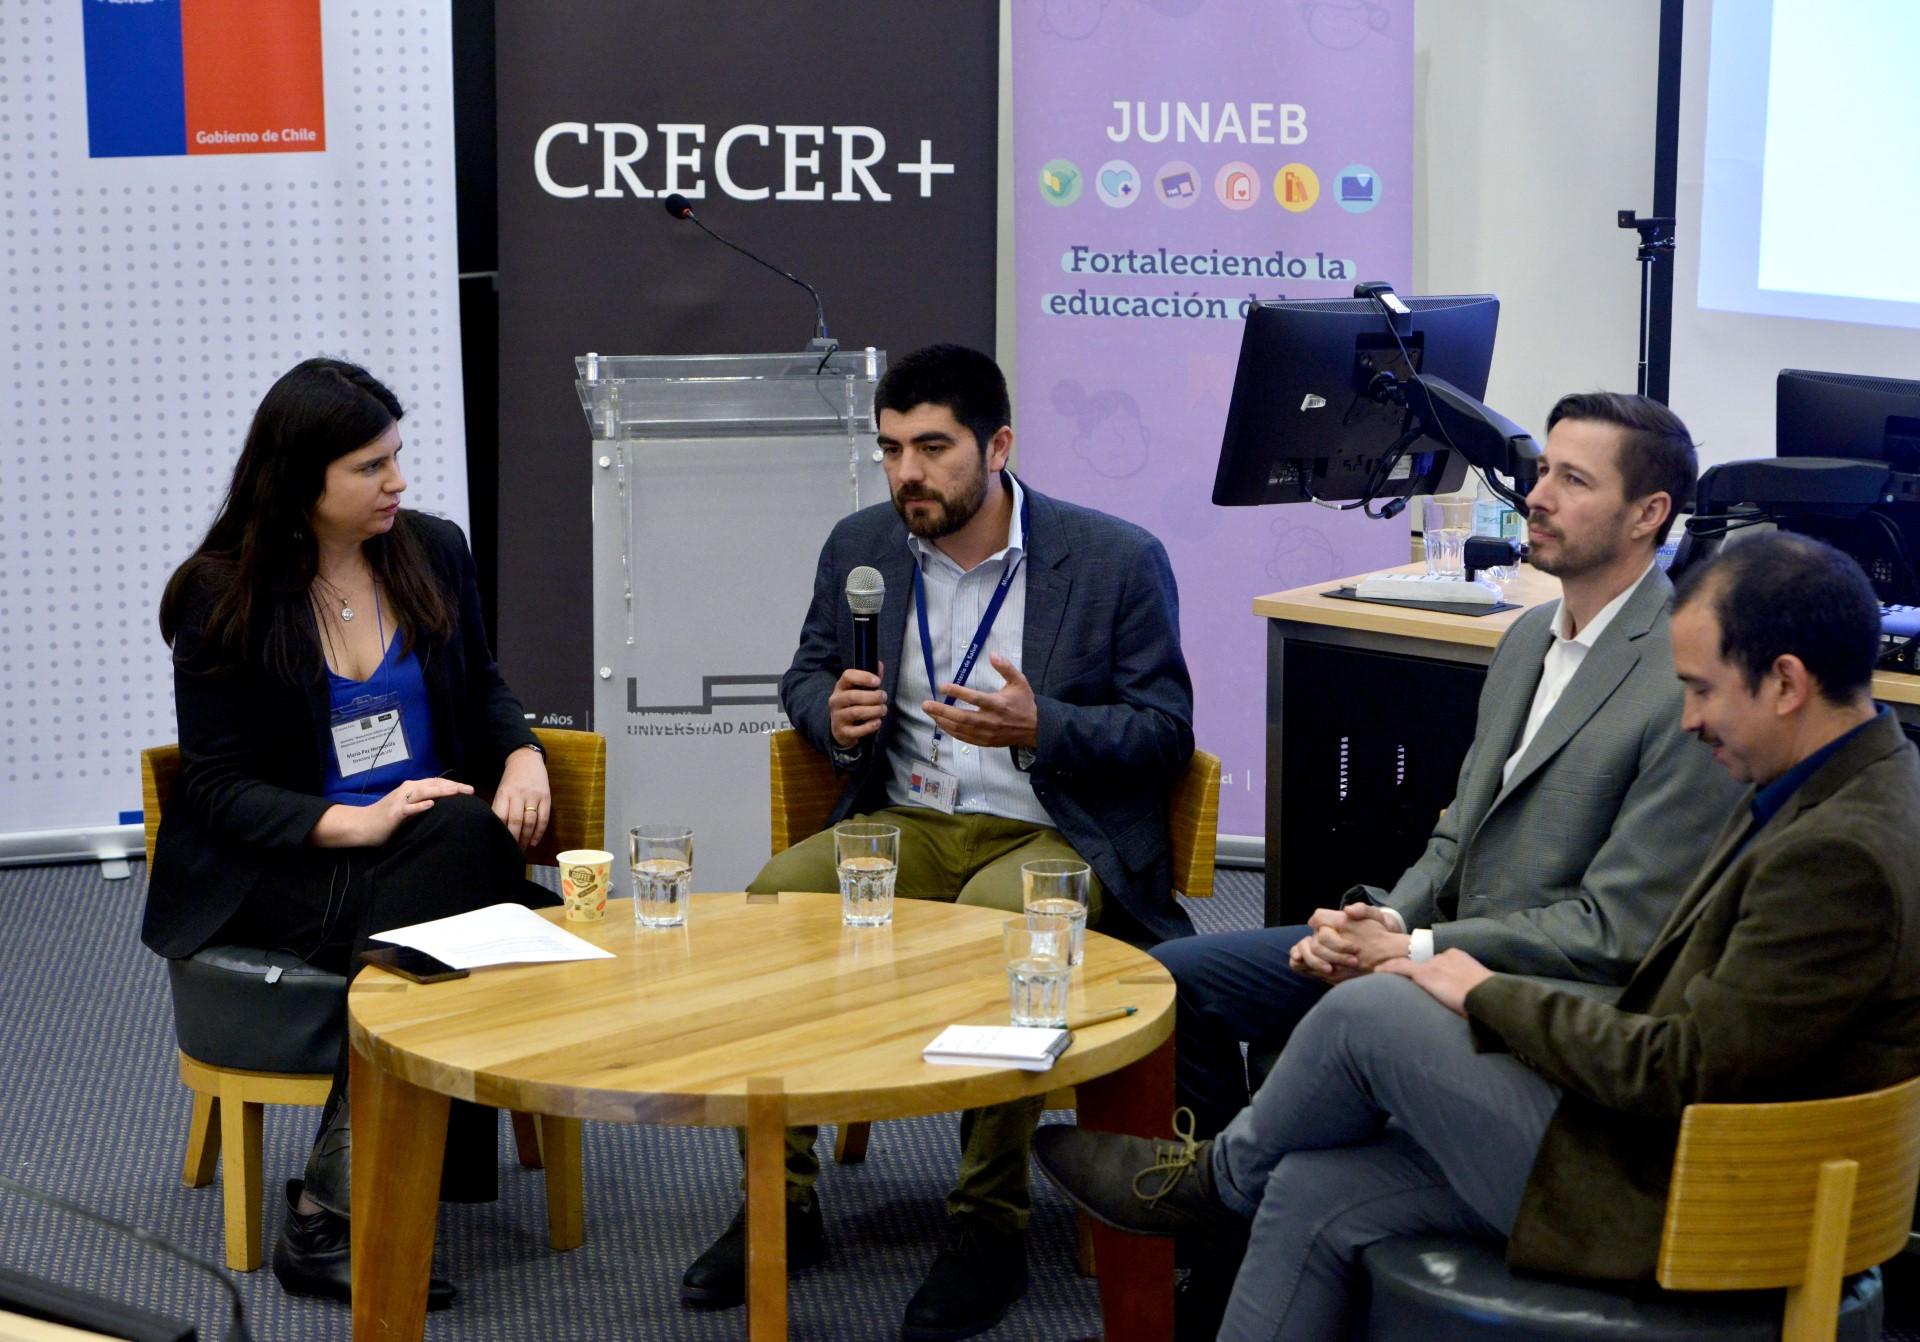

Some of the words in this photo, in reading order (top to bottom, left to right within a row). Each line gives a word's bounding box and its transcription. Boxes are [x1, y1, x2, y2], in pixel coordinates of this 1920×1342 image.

[196, 129, 259, 144] Gobierno
[262, 129, 279, 143] de
[281, 127, 317, 142] Chile
[1106, 101, 1308, 145] JUNAEB
[533, 121, 955, 202] CRECER+
[1069, 246, 1307, 278] Fortaleciendo
[1316, 252, 1347, 280] la
[1050, 289, 1227, 319] educación
[541, 713, 574, 725] AÑOS
[627, 722, 734, 736] UNIVERSIDAD
